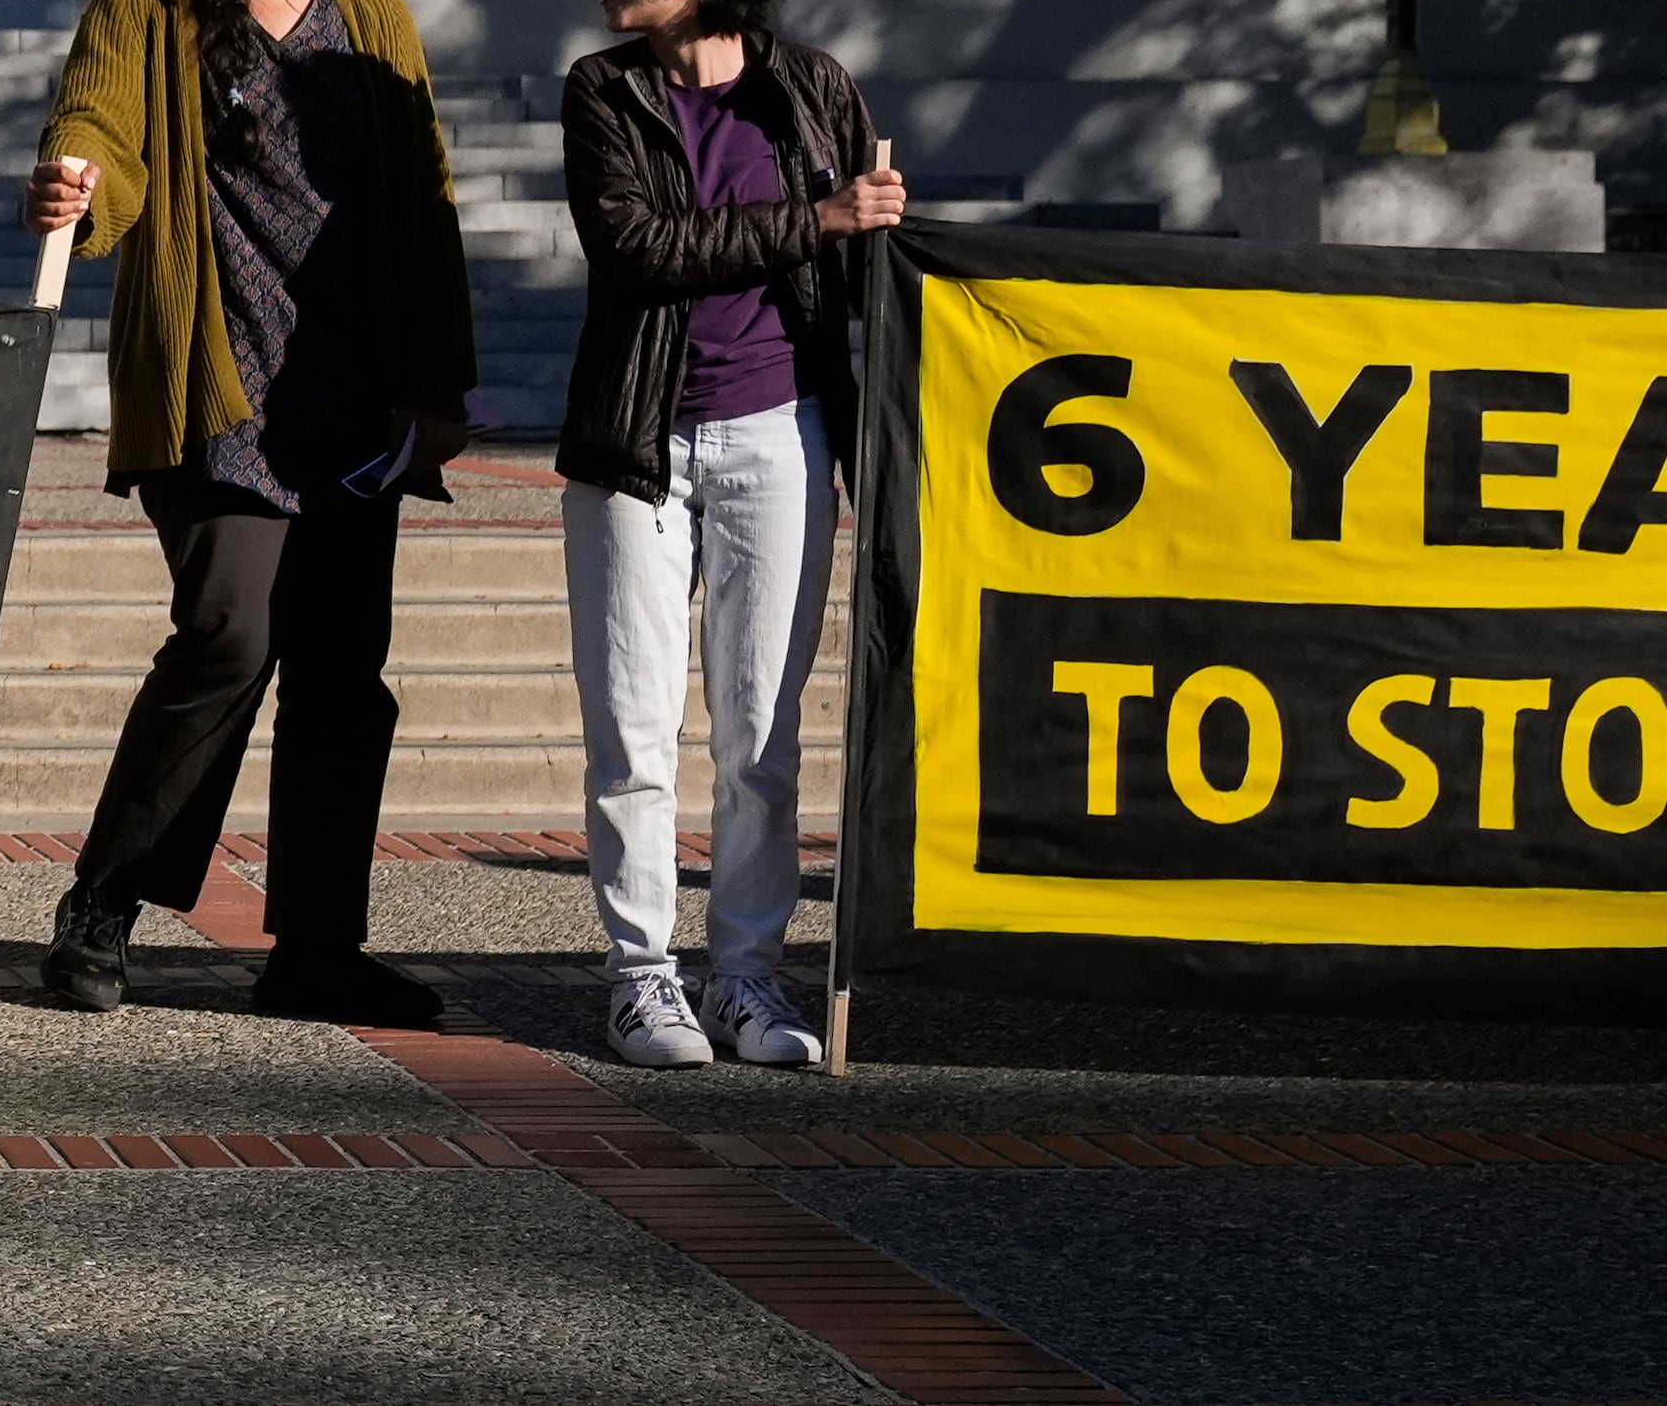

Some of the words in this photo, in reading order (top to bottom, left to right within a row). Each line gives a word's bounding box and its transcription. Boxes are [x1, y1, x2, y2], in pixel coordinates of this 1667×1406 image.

[987, 353, 1147, 537] 6
[1052, 659, 1283, 826] TO
[1345, 673, 1667, 836] STO
